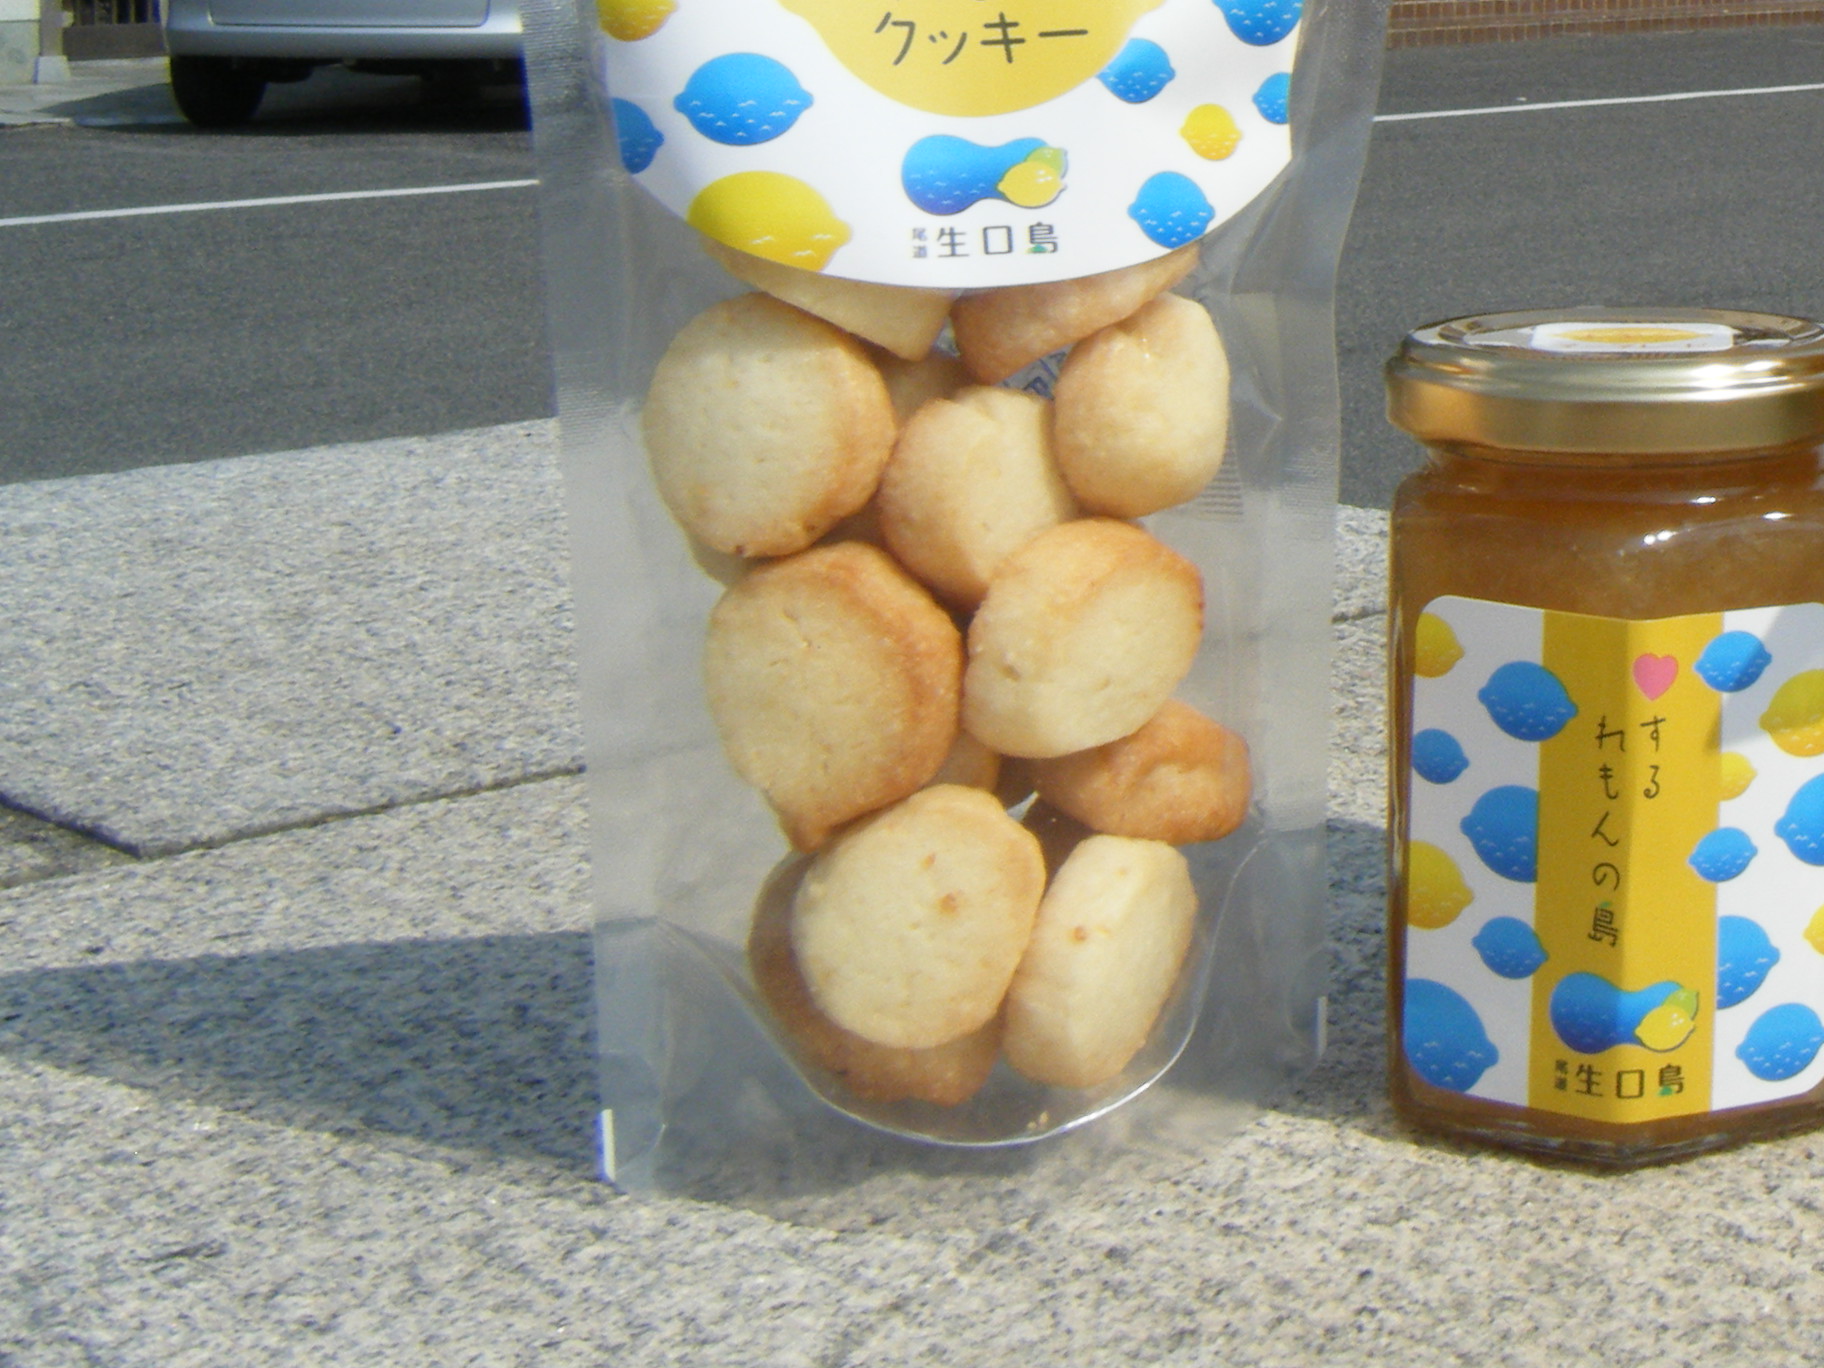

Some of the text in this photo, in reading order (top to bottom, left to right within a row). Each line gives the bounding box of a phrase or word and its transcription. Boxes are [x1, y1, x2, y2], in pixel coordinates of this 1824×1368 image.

[874, 11, 1089, 66] クッキー
[1640, 715, 1666, 799] する
[1587, 715, 1626, 948] れもんの島
